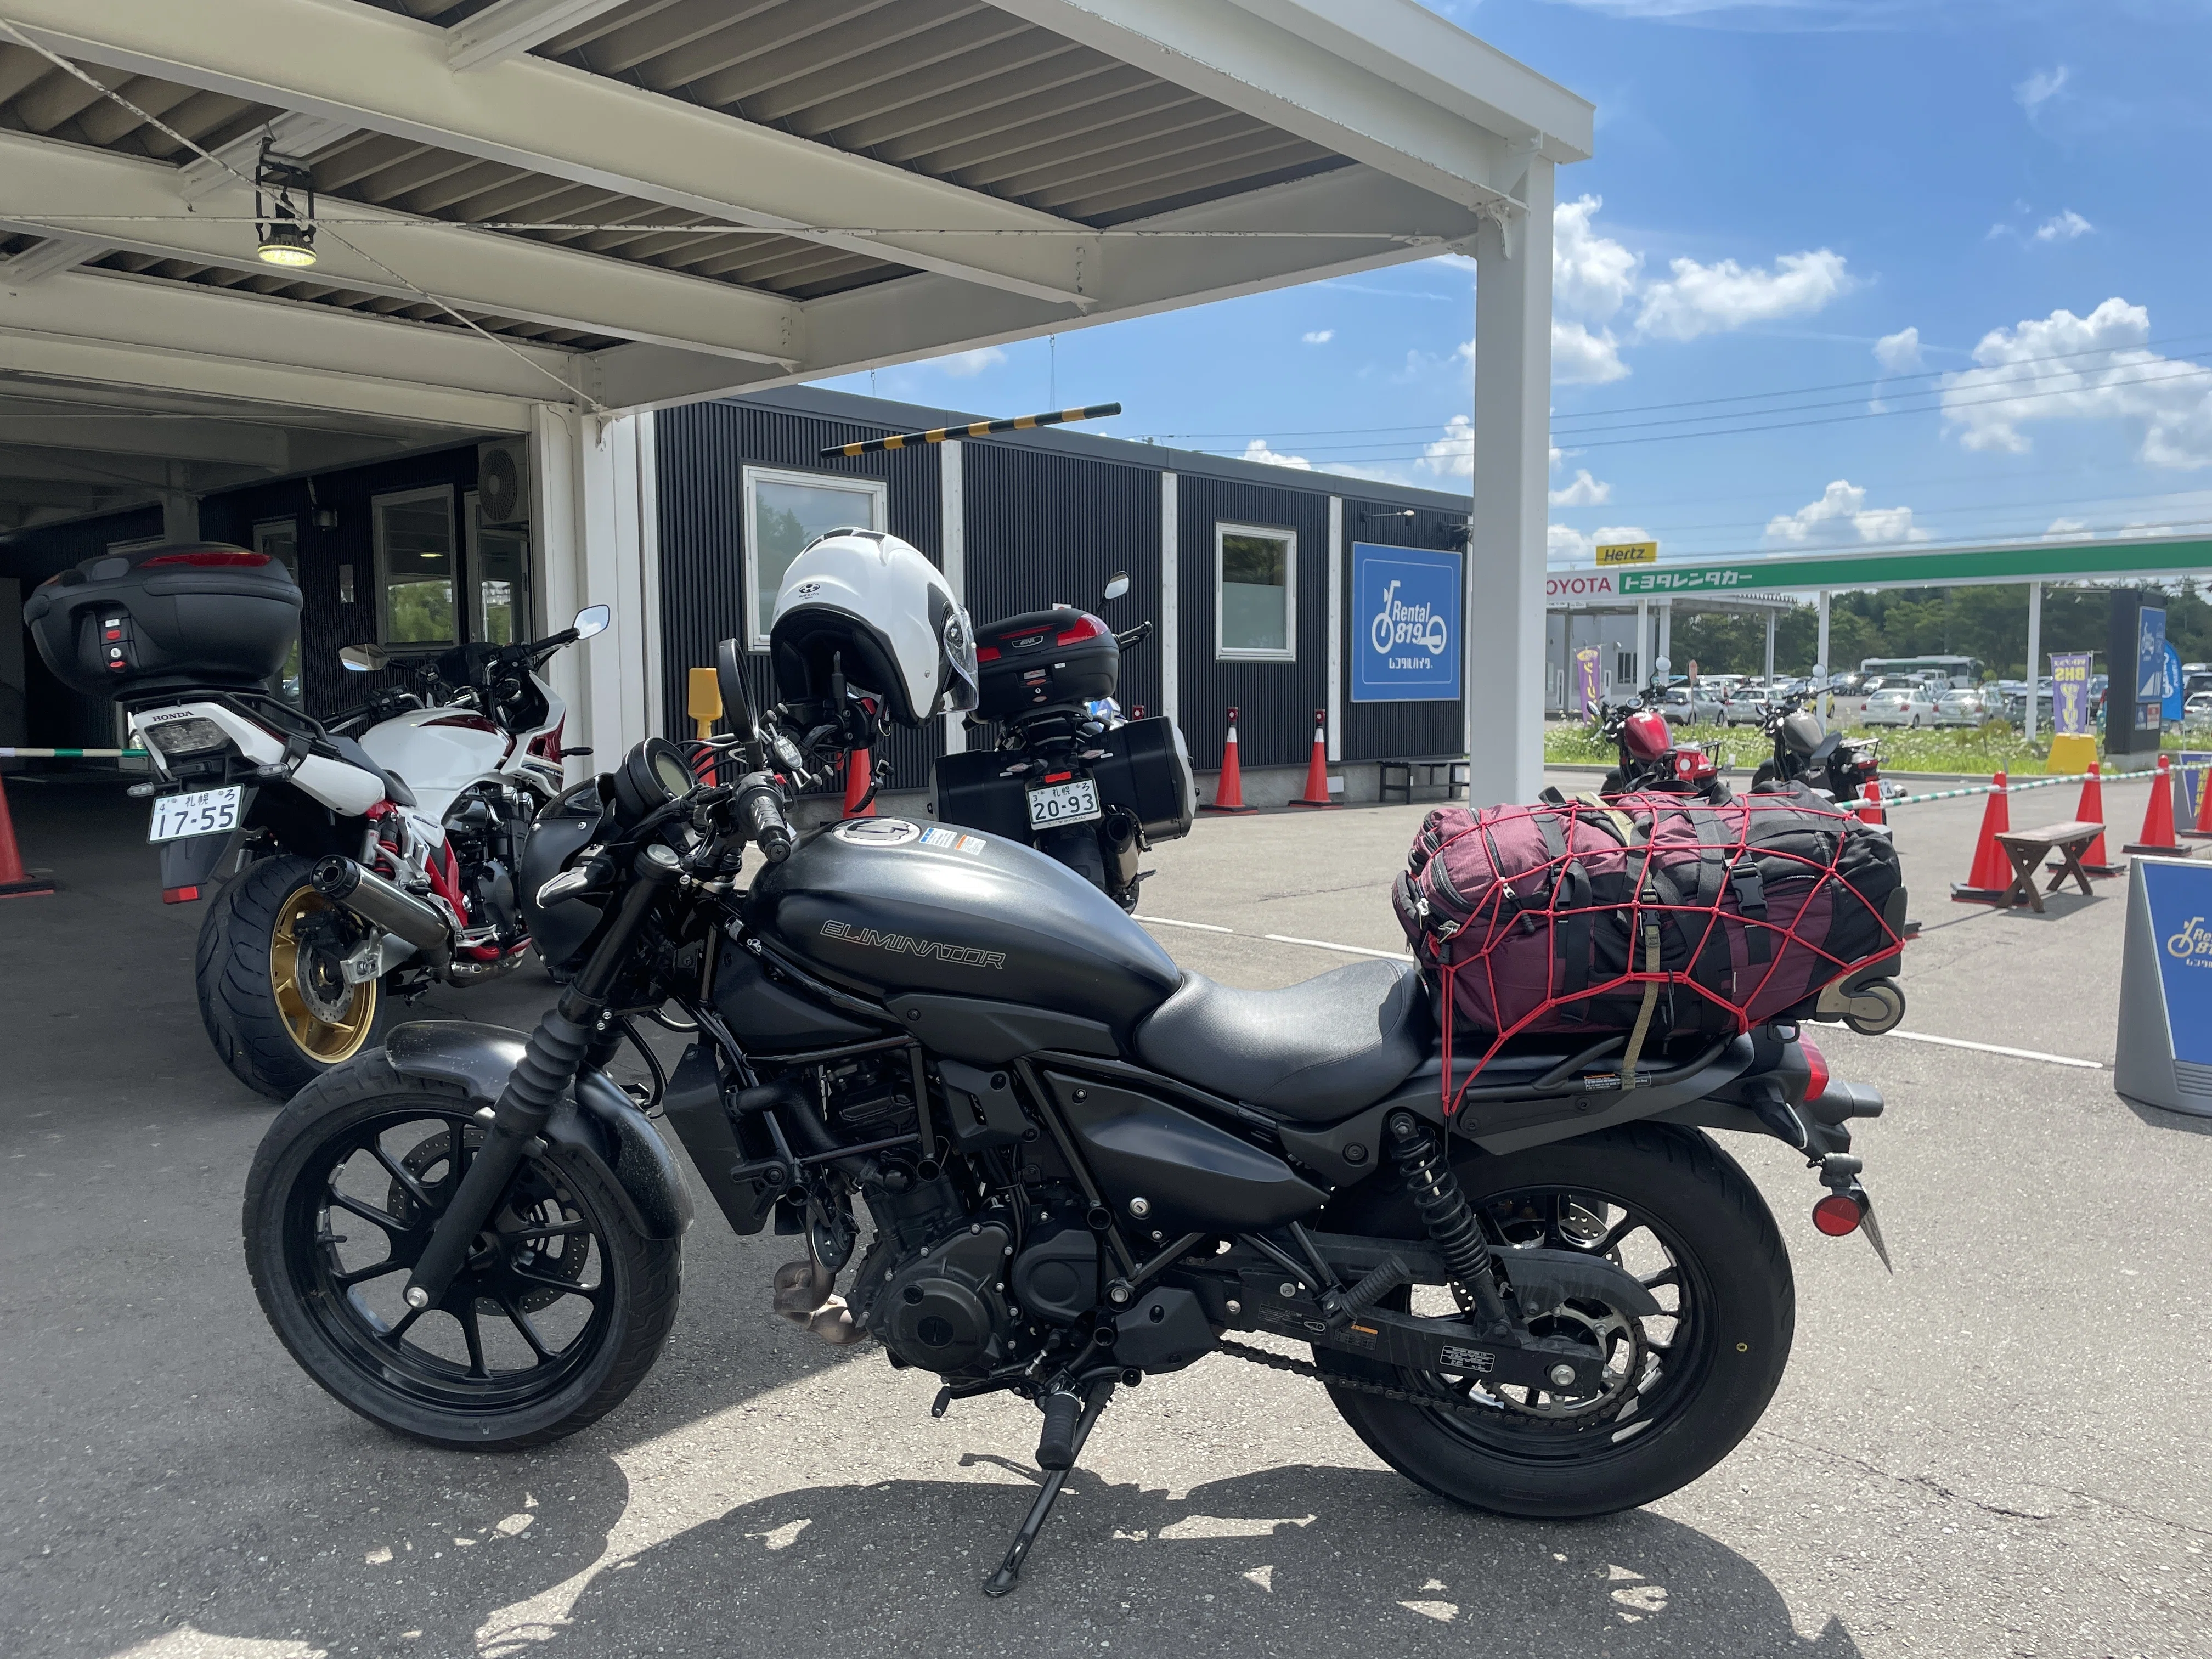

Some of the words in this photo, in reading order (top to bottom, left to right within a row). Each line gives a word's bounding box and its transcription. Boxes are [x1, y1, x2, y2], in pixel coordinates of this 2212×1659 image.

[1604, 547, 1645, 562] Hertz
[1547, 577, 1612, 595] OYOTA
[1624, 570, 1753, 590] トヨタレンタカー
[1392, 600, 1430, 623] Rental
[1395, 622, 1423, 644] 819
[152, 711, 194, 721] HONDA
[185, 793, 209, 808] 札幌
[224, 789, 235, 801] ろ
[1052, 786, 1070, 797] 札幌
[1081, 782, 1090, 791] ろ
[1033, 793, 1094, 820] 20-93
[158, 803, 235, 838] 17-55
[820, 919, 1006, 970] ELIMINATOR
[2193, 928, 2212, 942] Re
[2195, 941, 2212, 955] 8
